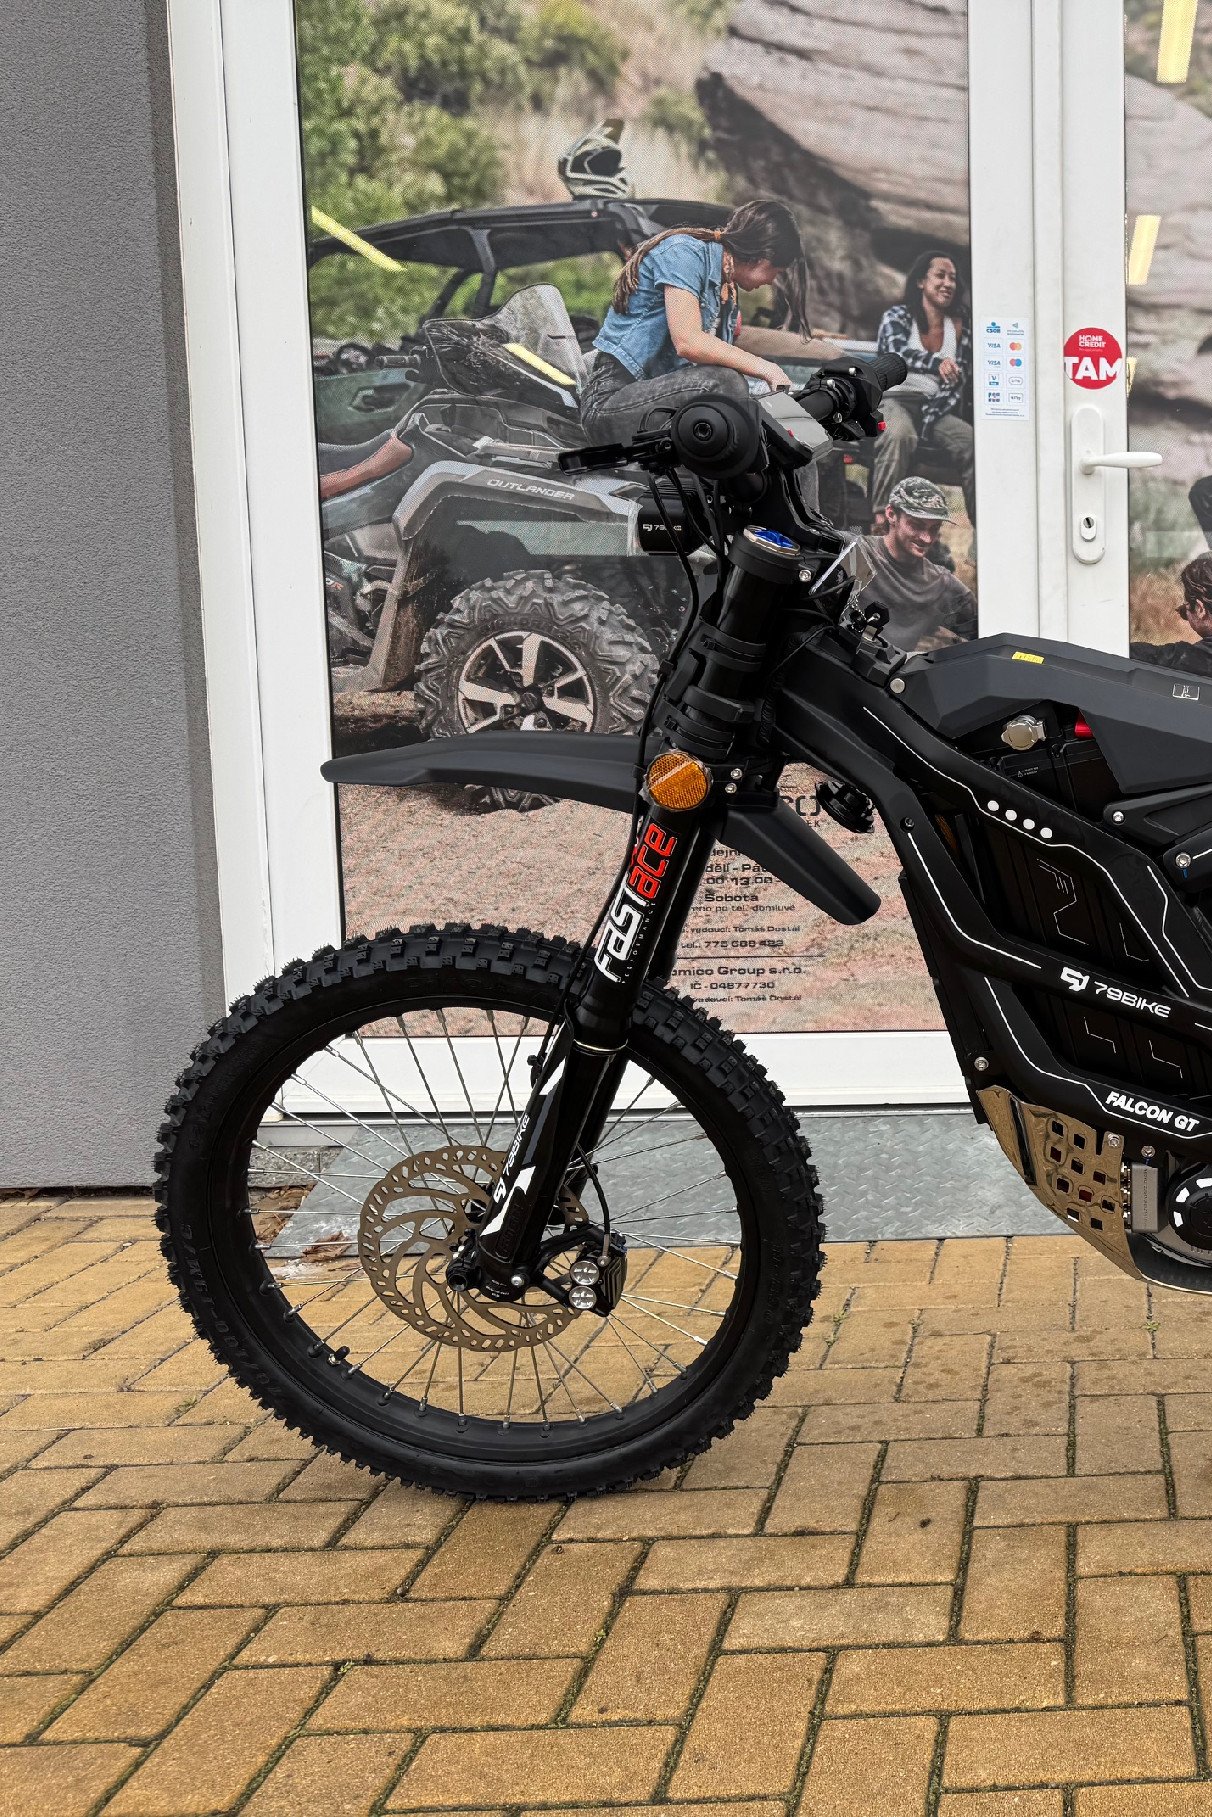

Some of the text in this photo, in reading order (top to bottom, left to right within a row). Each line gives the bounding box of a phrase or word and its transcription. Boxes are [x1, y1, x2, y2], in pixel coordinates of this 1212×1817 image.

[1078, 334, 1104, 342] HOME
[1064, 356, 1123, 381] TAM
[487, 479, 575, 501] OUTLANDER
[717, 966, 766, 977] Group
[1094, 980, 1171, 1018] 79BIKE
[1105, 1090, 1200, 1132] FALCON GT
